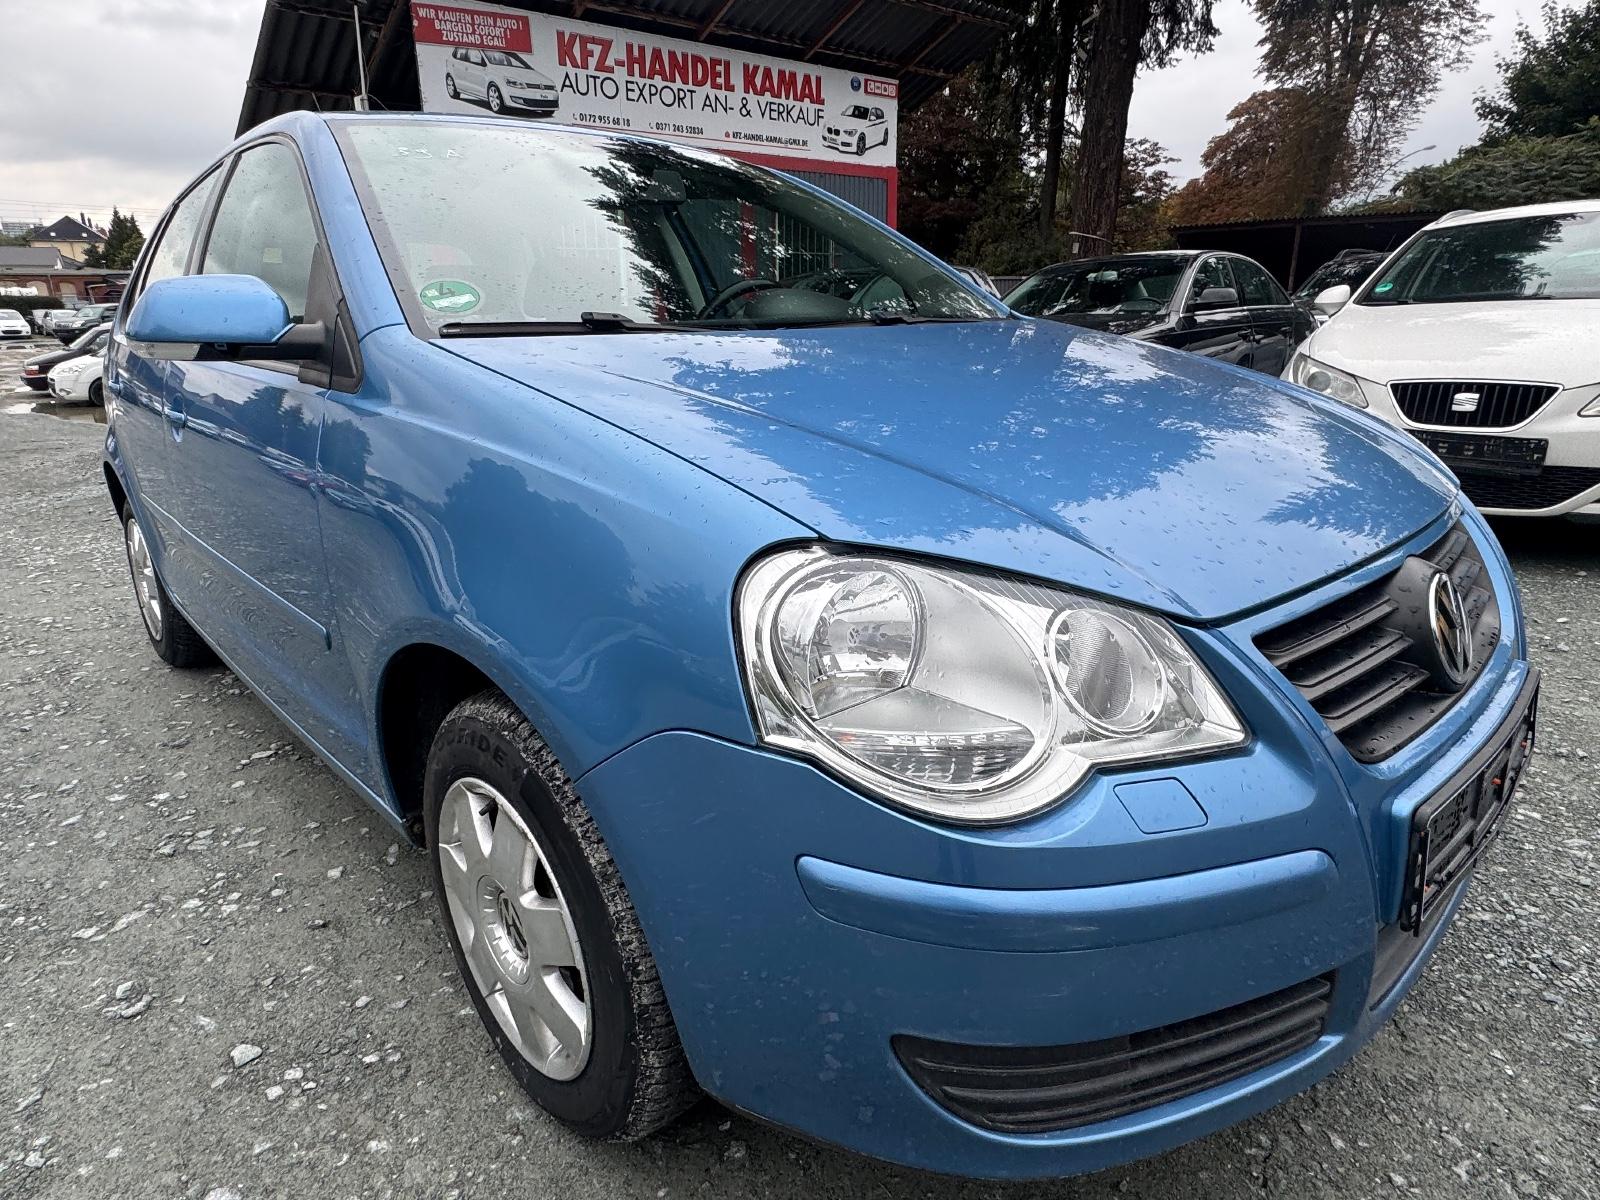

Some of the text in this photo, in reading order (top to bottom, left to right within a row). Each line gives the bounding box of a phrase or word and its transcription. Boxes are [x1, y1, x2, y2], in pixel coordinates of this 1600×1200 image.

[417, 7, 436, 19] WIR
[437, 10, 471, 24] KAUFEN
[474, 15, 494, 26] DEIN
[497, 18, 517, 28] AUTO
[434, 20, 472, 34] BARGELD
[475, 26, 504, 37] SOFORT
[442, 31, 506, 47] ZUSTAND EGAL!
[556, 29, 825, 105] KFZ-HANDEL KAMAL
[560, 71, 824, 127] AUTO EXPORT AN- & VERKAUF
[579, 112, 630, 127] 0172 955 68 18
[655, 122, 704, 135] 0371 243 52834
